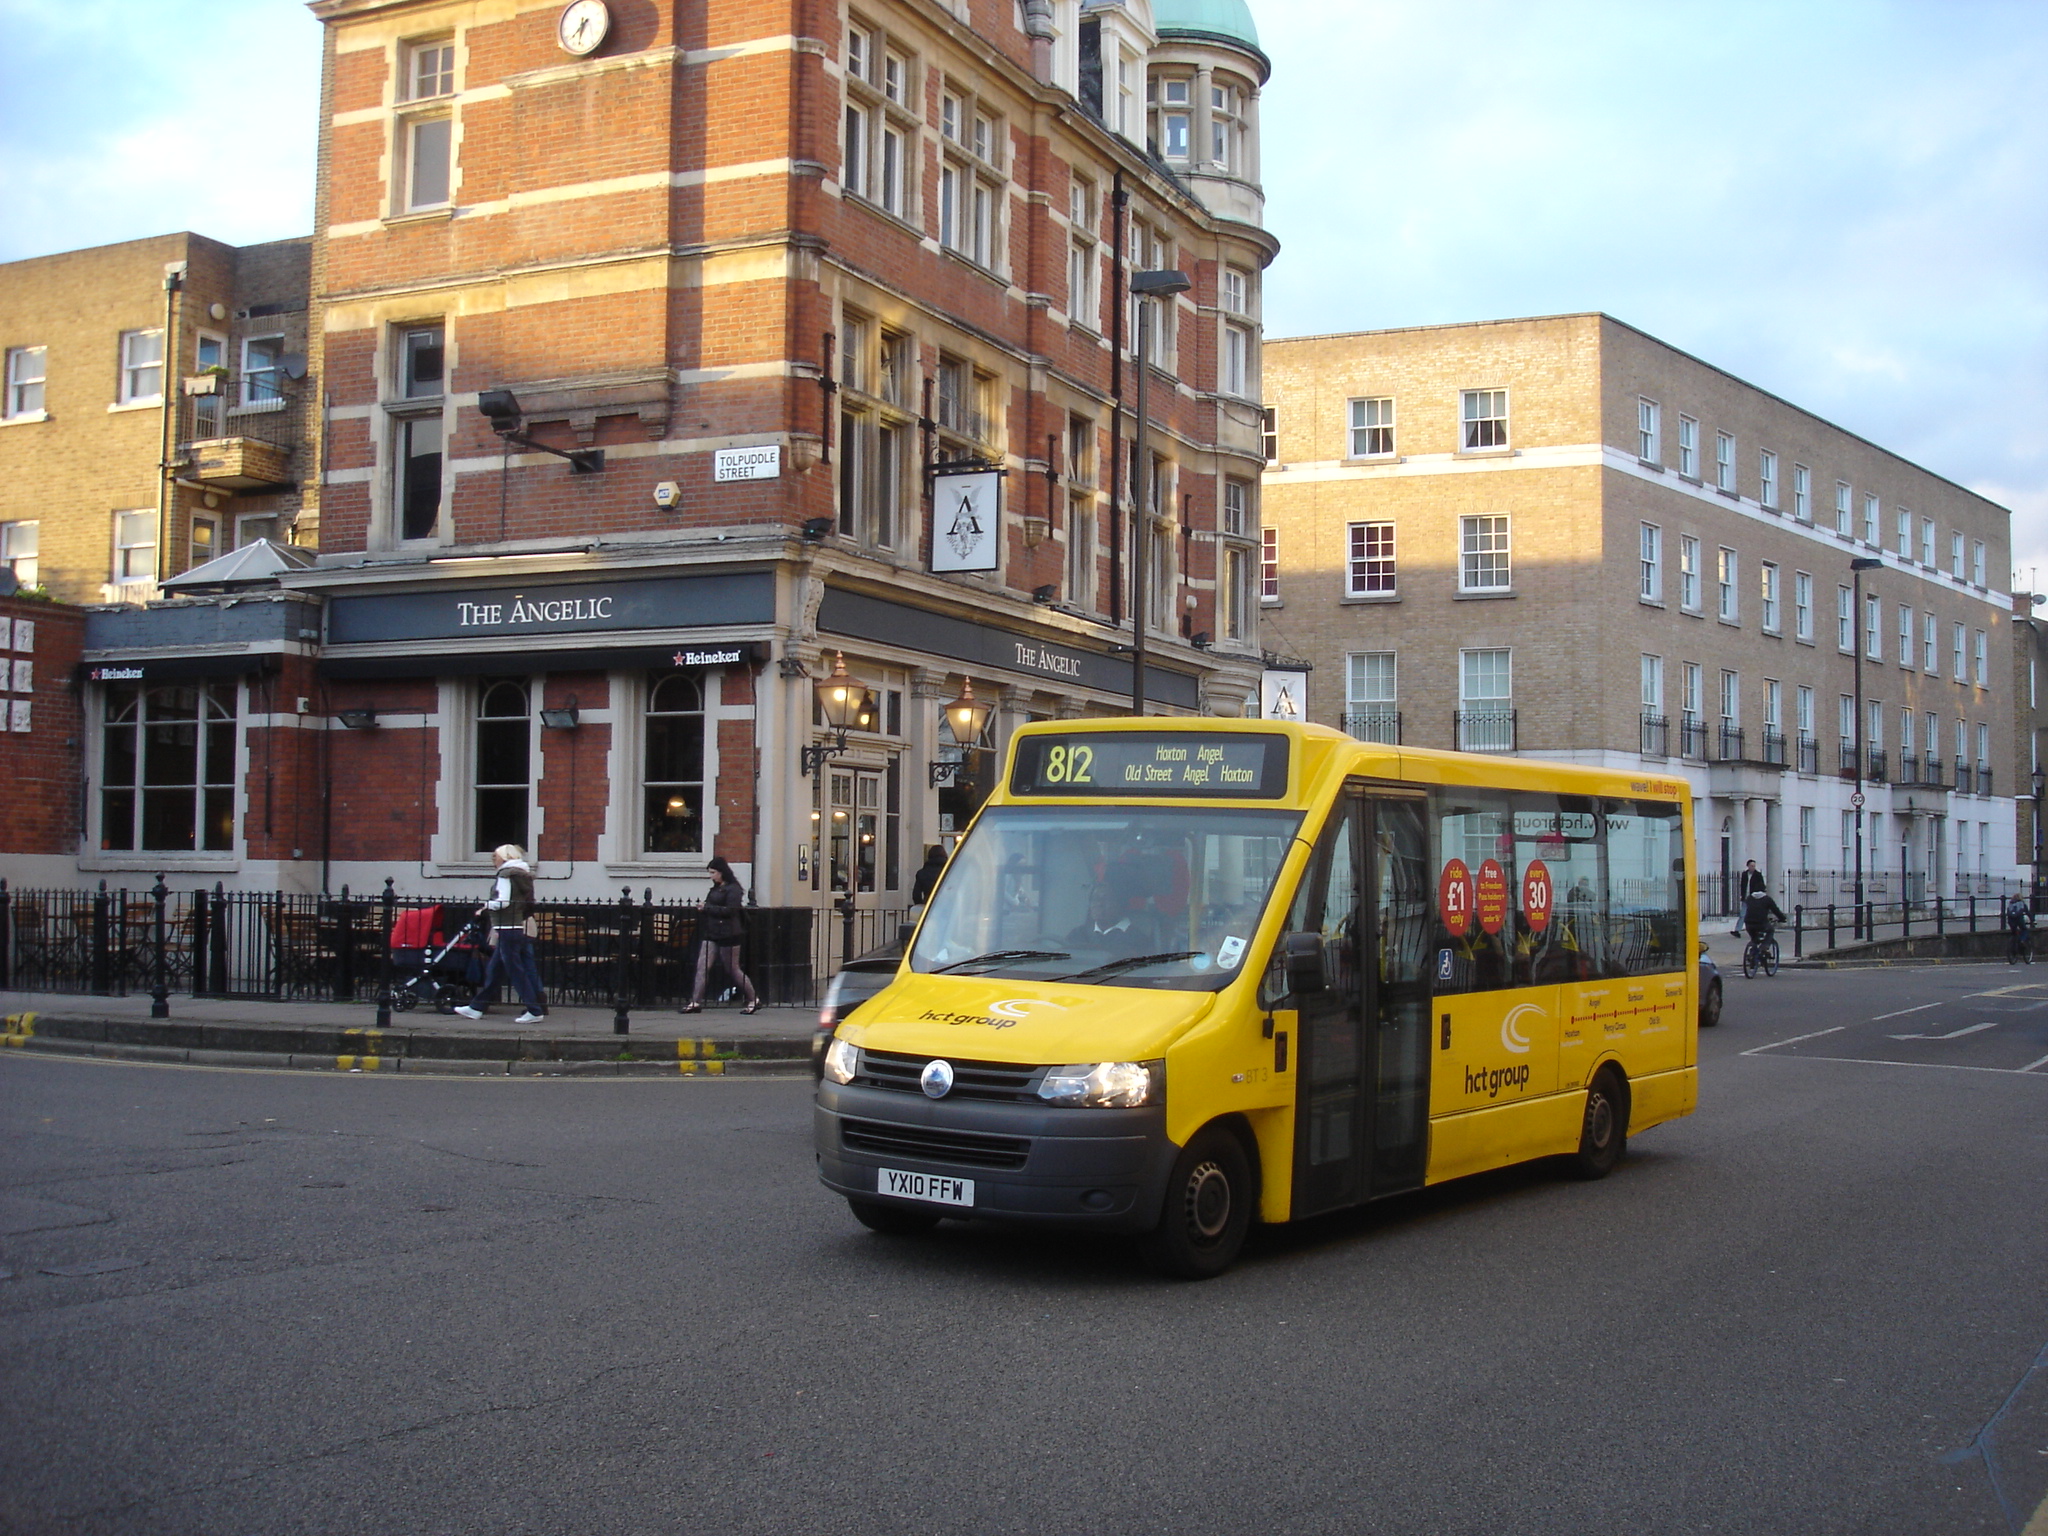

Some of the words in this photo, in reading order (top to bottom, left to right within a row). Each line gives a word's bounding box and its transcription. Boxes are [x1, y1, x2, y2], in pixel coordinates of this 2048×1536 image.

[719, 452, 776, 467] TOLPUDDLE
[719, 466, 756, 479] STREET
[457, 602, 502, 626] THE
[685, 650, 740, 665] Heineken
[1015, 642, 1036, 667] THE
[101, 667, 143, 680] Heineken
[1046, 745, 1094, 783] 812
[1155, 745, 1187, 761] Hoxton
[1197, 744, 1223, 764] Angel
[1125, 764, 1142, 781] Old
[1144, 764, 1173, 782] Street
[1183, 764, 1209, 785] Angel
[1220, 765, 1253, 783] Hoxton
[1449, 866, 1463, 879] ride
[1484, 866, 1498, 879] free
[1529, 868, 1545, 881] every
[1447, 881, 1465, 911] £1
[1529, 881, 1546, 909] 30
[1450, 911, 1464, 927] only
[1531, 909, 1545, 920] mins
[918, 1009, 955, 1021] hct
[949, 1013, 1017, 1030] group
[1465, 1064, 1488, 1094] hct
[1489, 1064, 1530, 1098] group
[888, 1171, 924, 1195] YX10
[929, 1177, 963, 1201] FFW
